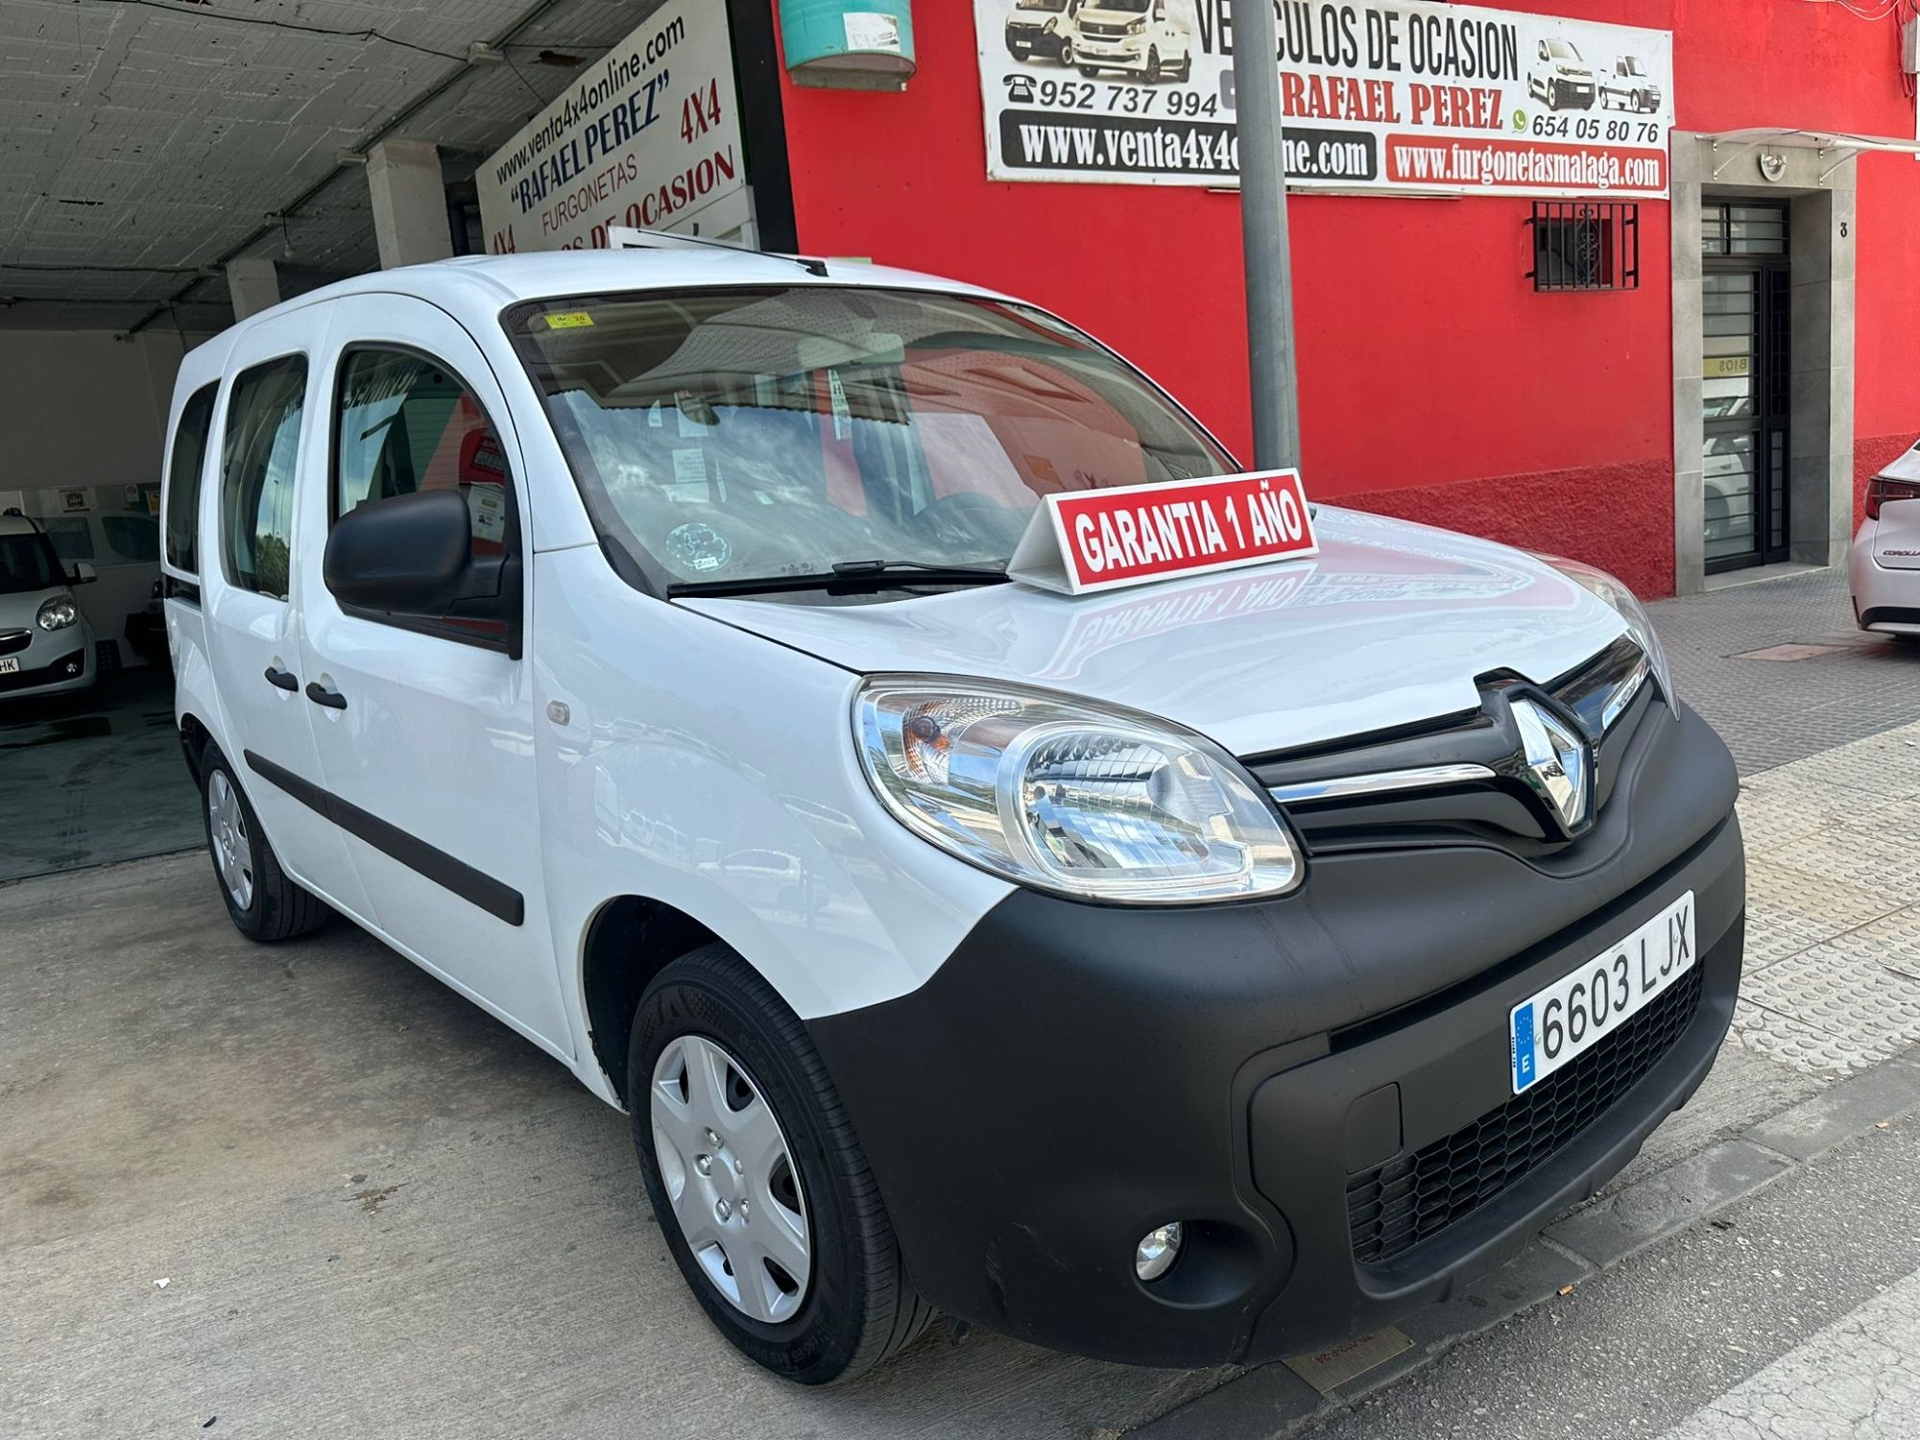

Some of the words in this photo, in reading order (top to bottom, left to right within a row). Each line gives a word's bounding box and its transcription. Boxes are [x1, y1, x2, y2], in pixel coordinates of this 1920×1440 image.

[1365, 9, 1402, 71] DE
[1409, 13, 1519, 81] OCASION
[496, 15, 685, 186] www.venta4x4online.com
[681, 77, 721, 144] 4X4
[1039, 80, 1096, 109] 952
[1107, 85, 1157, 114] 737
[1167, 91, 1218, 118] 994
[1280, 72, 1401, 124] RAFAEL
[1409, 83, 1504, 130] PEREZ
[1532, 114, 1569, 138] 654
[1575, 117, 1600, 140] 05
[1606, 119, 1630, 142] 80
[1636, 121, 1659, 143] 76
[541, 153, 638, 236] FURGONETAS
[625, 144, 735, 231] OCASION
[1393, 143, 1660, 189] www.furgonetasmalaga.com
[1840, 222, 1848, 238] 3
[1075, 499, 1228, 574] GARANTIA
[1225, 496, 1246, 549] 1
[1247, 479, 1303, 547] AÑO
[1542, 953, 1630, 1060] 6603
[1641, 904, 1690, 995] LJX
[1521, 1054, 1531, 1074] E
